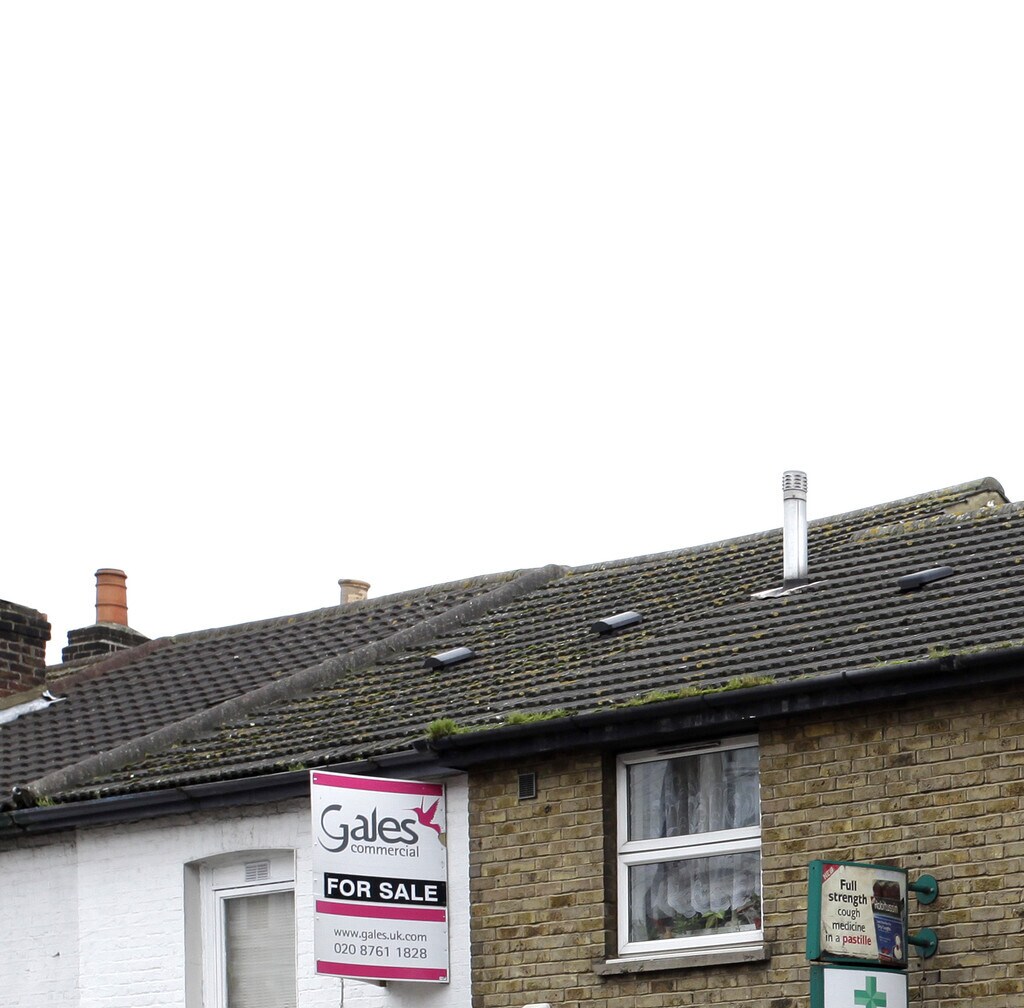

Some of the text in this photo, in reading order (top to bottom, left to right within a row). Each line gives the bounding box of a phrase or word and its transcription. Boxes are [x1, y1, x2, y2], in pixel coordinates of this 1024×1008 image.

[318, 804, 419, 853] Gales
[351, 844, 419, 857] commercial
[327, 877, 439, 902] FOR SALE
[840, 879, 857, 892] Full
[828, 892, 868, 908] strength
[837, 908, 861, 920] cough
[832, 922, 866, 933] medicine
[334, 928, 427, 942] www.gales.uk.com
[825, 932, 833, 942] in
[842, 935, 872, 946] pastille
[334, 943, 428, 959] 020 8761 1828
